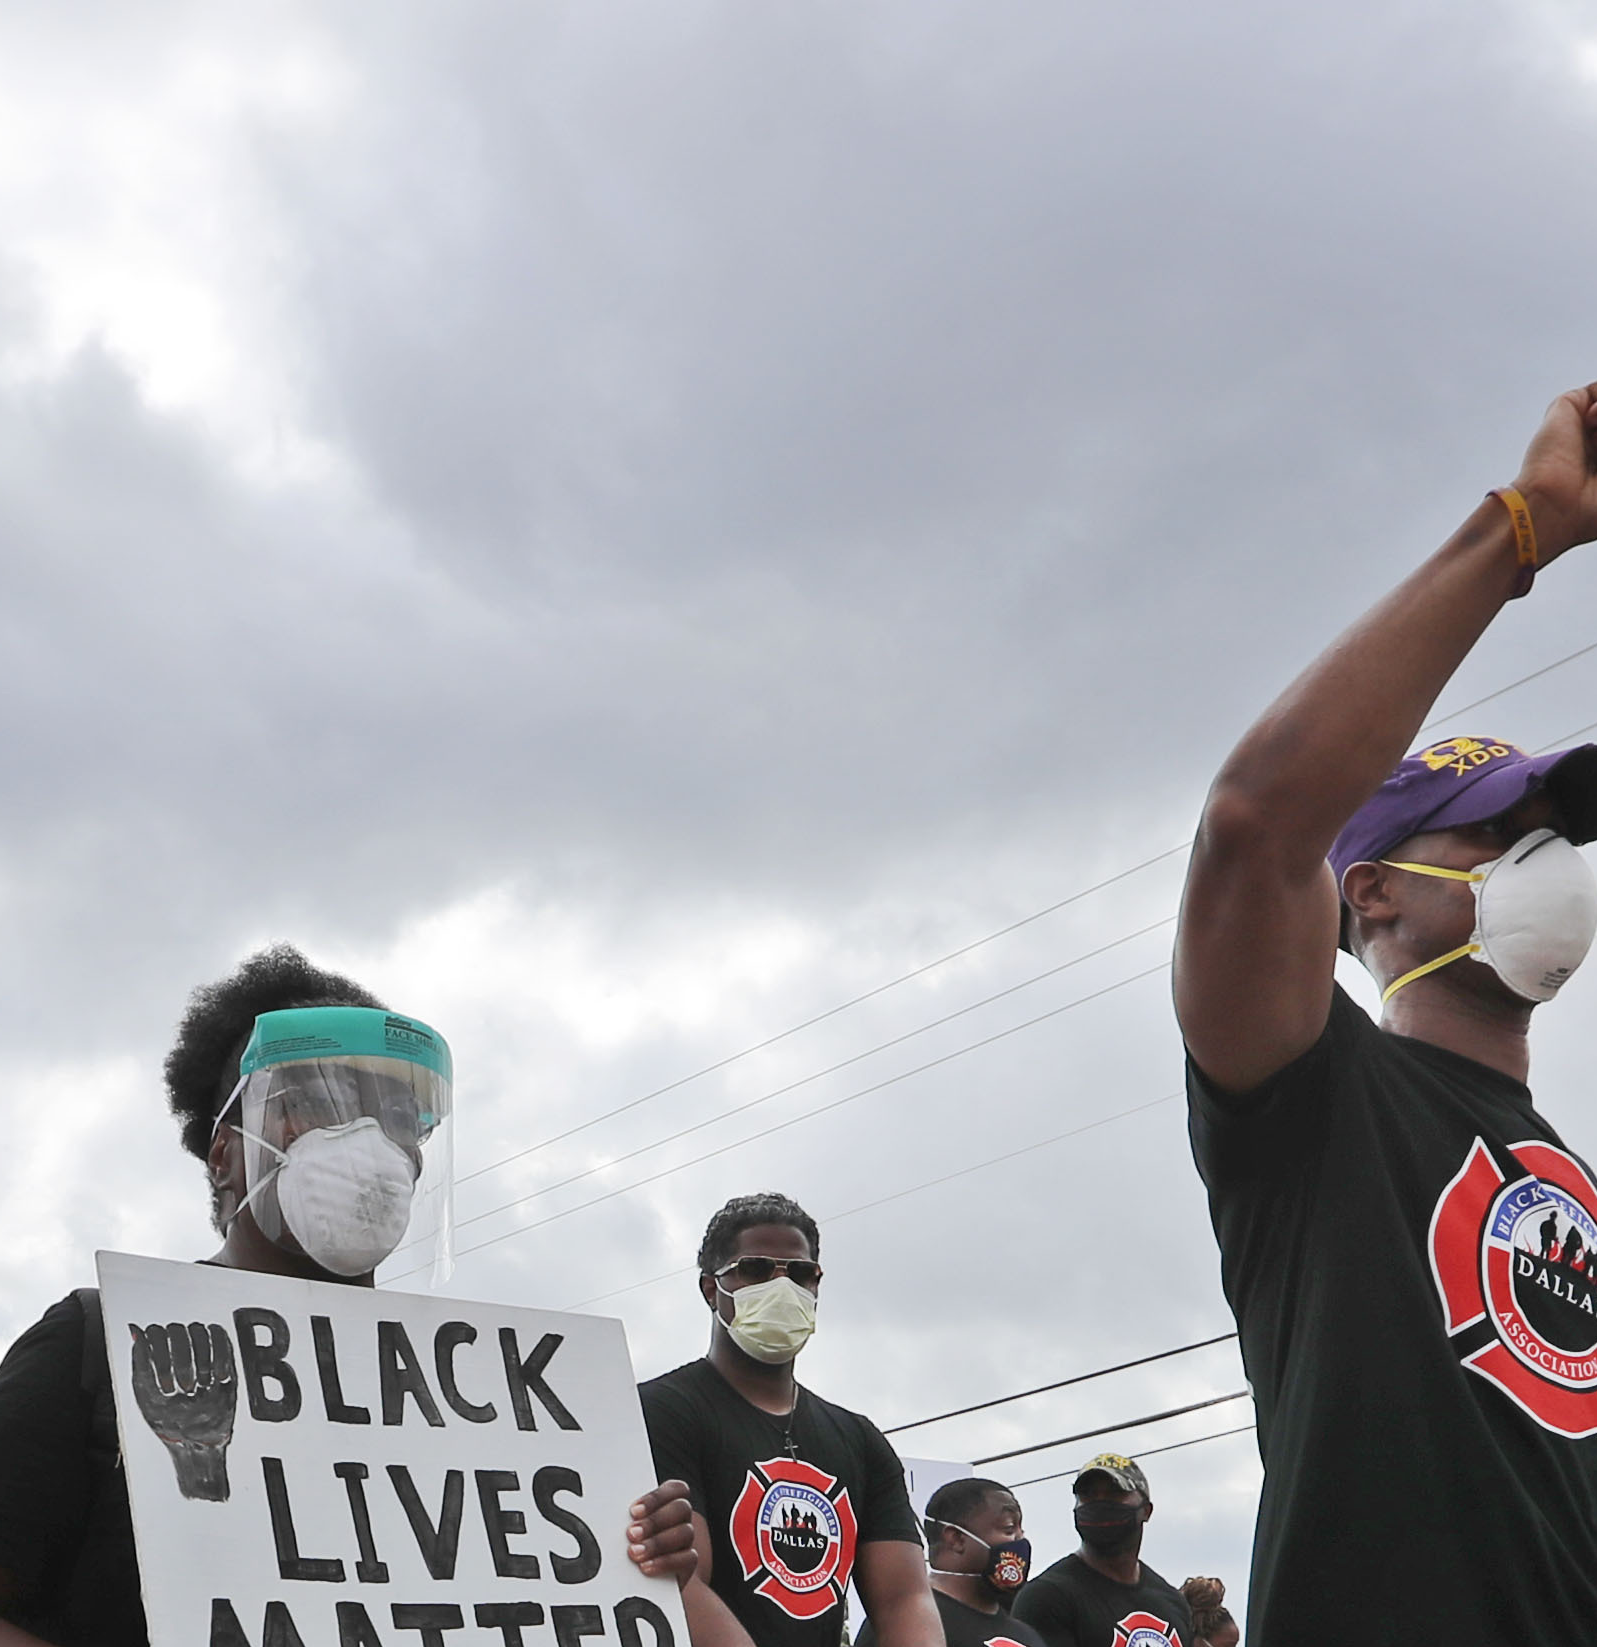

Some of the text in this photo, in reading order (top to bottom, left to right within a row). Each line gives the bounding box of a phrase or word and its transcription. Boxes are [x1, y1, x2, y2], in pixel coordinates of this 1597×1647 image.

[1497, 1185, 1546, 1237] BLACK
[233, 1307, 583, 1432] BLACK
[261, 1455, 604, 1585] LIVES
[773, 1530, 825, 1549] DALLAS
